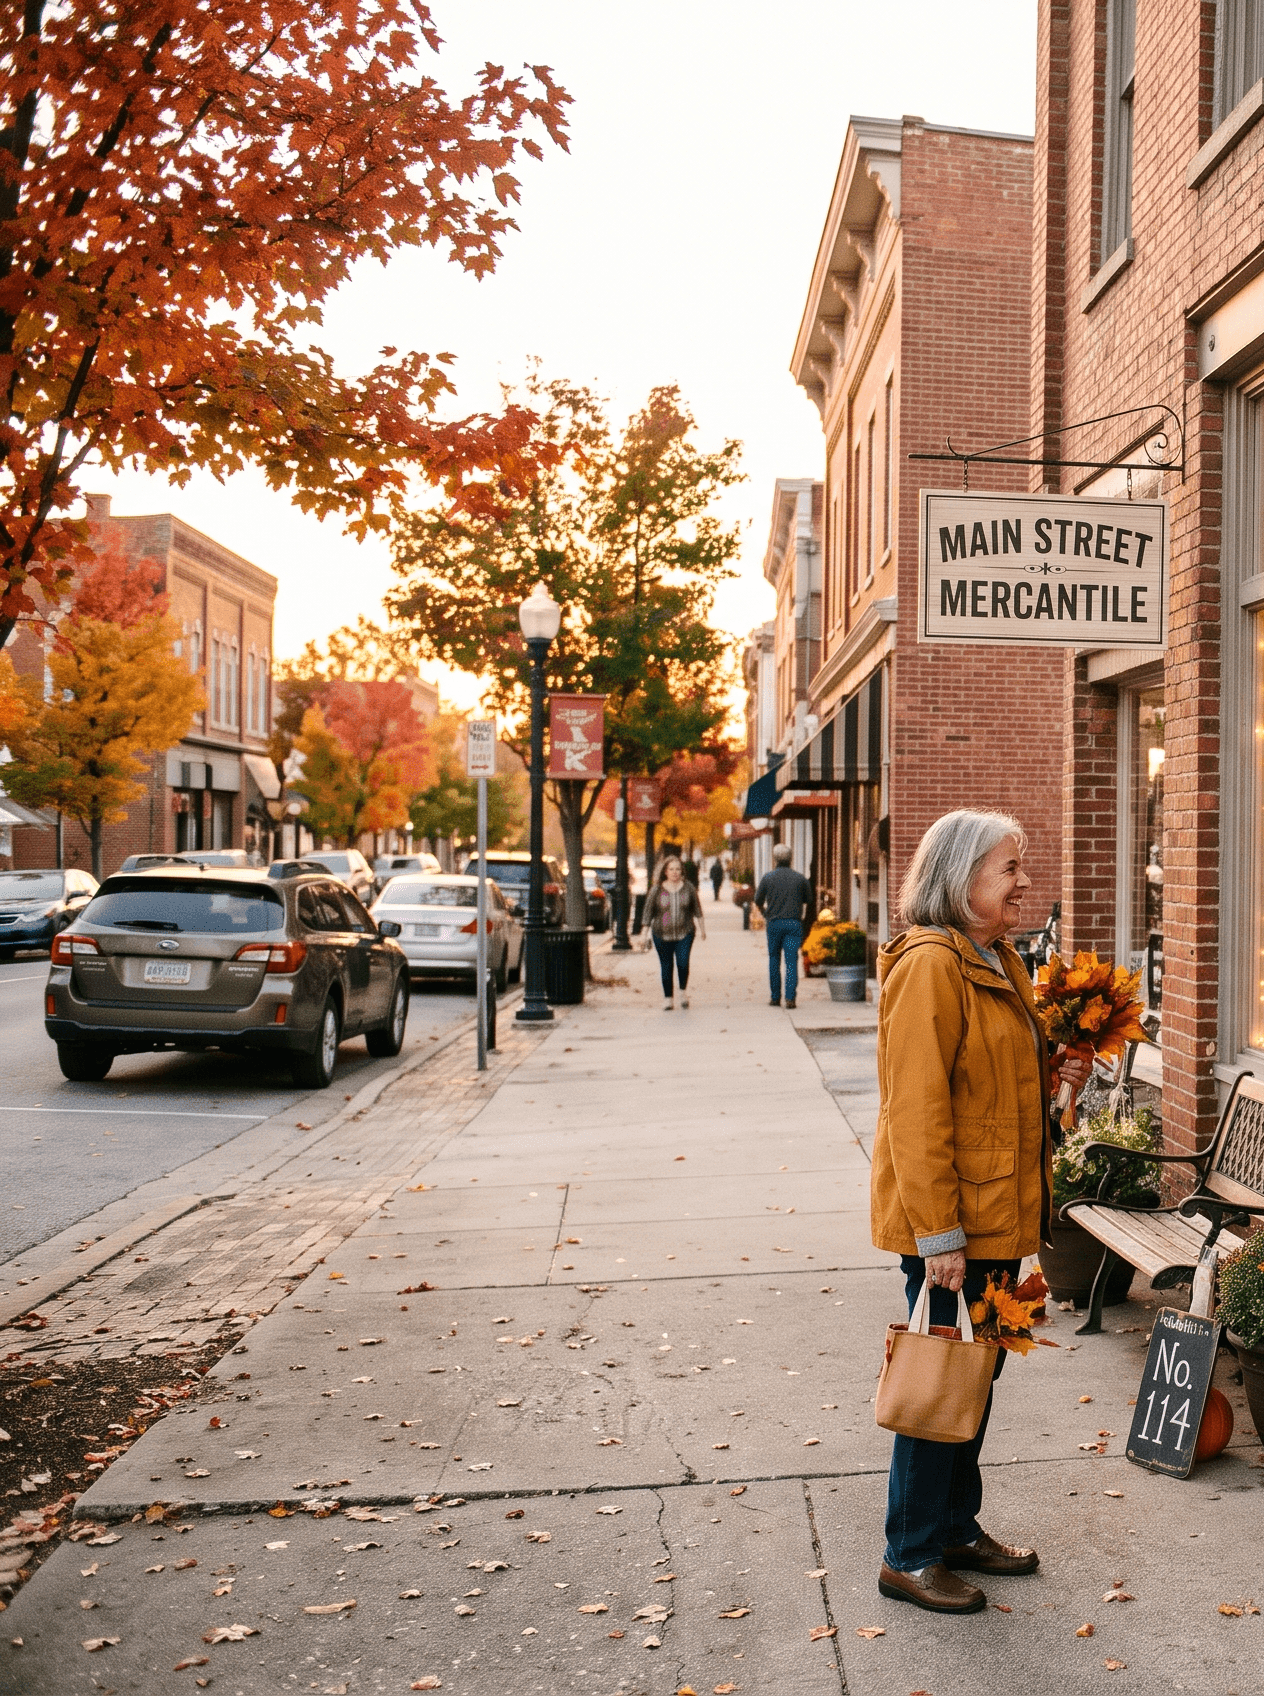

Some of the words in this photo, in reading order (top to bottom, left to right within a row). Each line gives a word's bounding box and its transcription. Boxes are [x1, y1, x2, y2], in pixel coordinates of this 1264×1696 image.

[940, 517, 1022, 563] MAIN
[1034, 517, 1154, 570] STREET
[940, 579, 1148, 623] MERCANTILE
[1152, 1338, 1193, 1390] No.
[1137, 1390, 1191, 1451] 114
